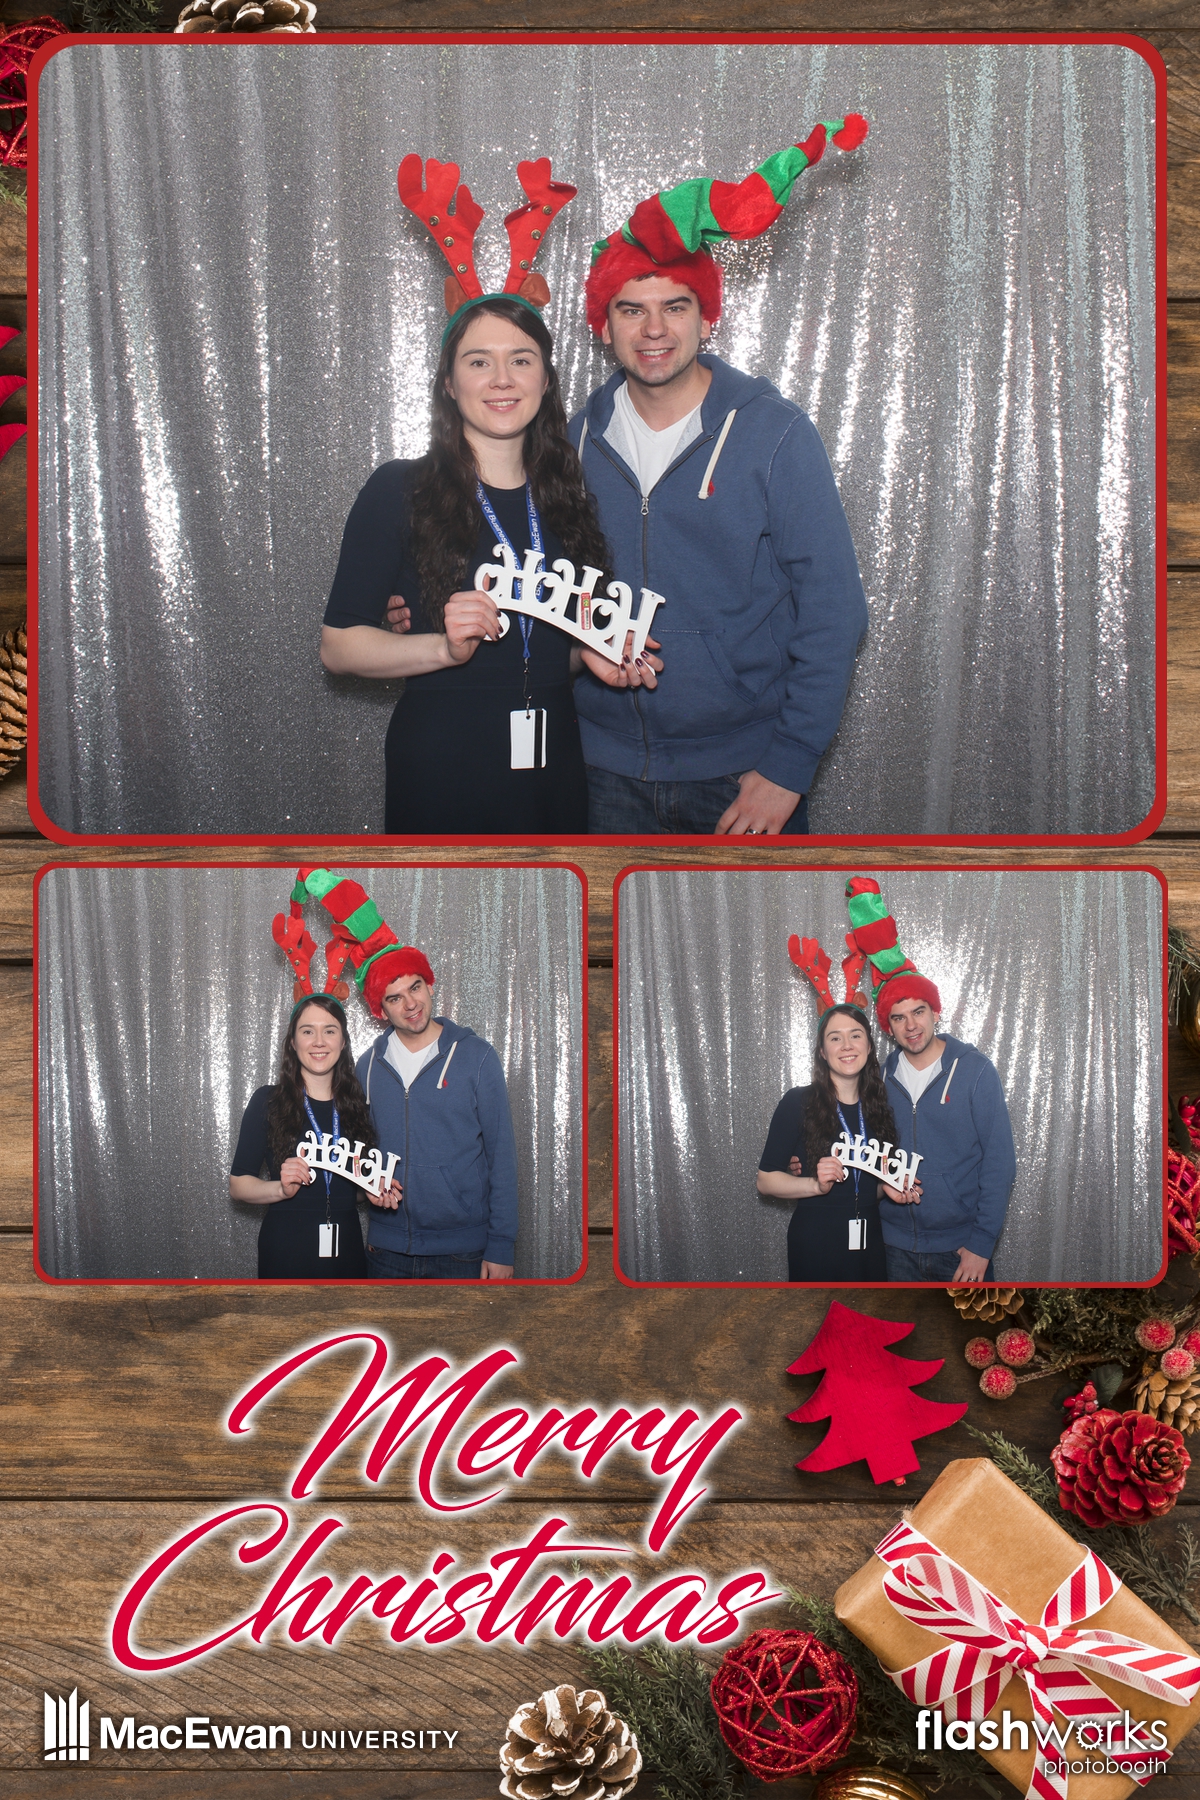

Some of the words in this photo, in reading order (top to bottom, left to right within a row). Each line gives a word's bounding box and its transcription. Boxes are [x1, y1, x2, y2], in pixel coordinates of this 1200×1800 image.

[484, 506, 494, 514] of
[489, 514, 510, 546] Business
[531, 518, 542, 552] MacEwan
